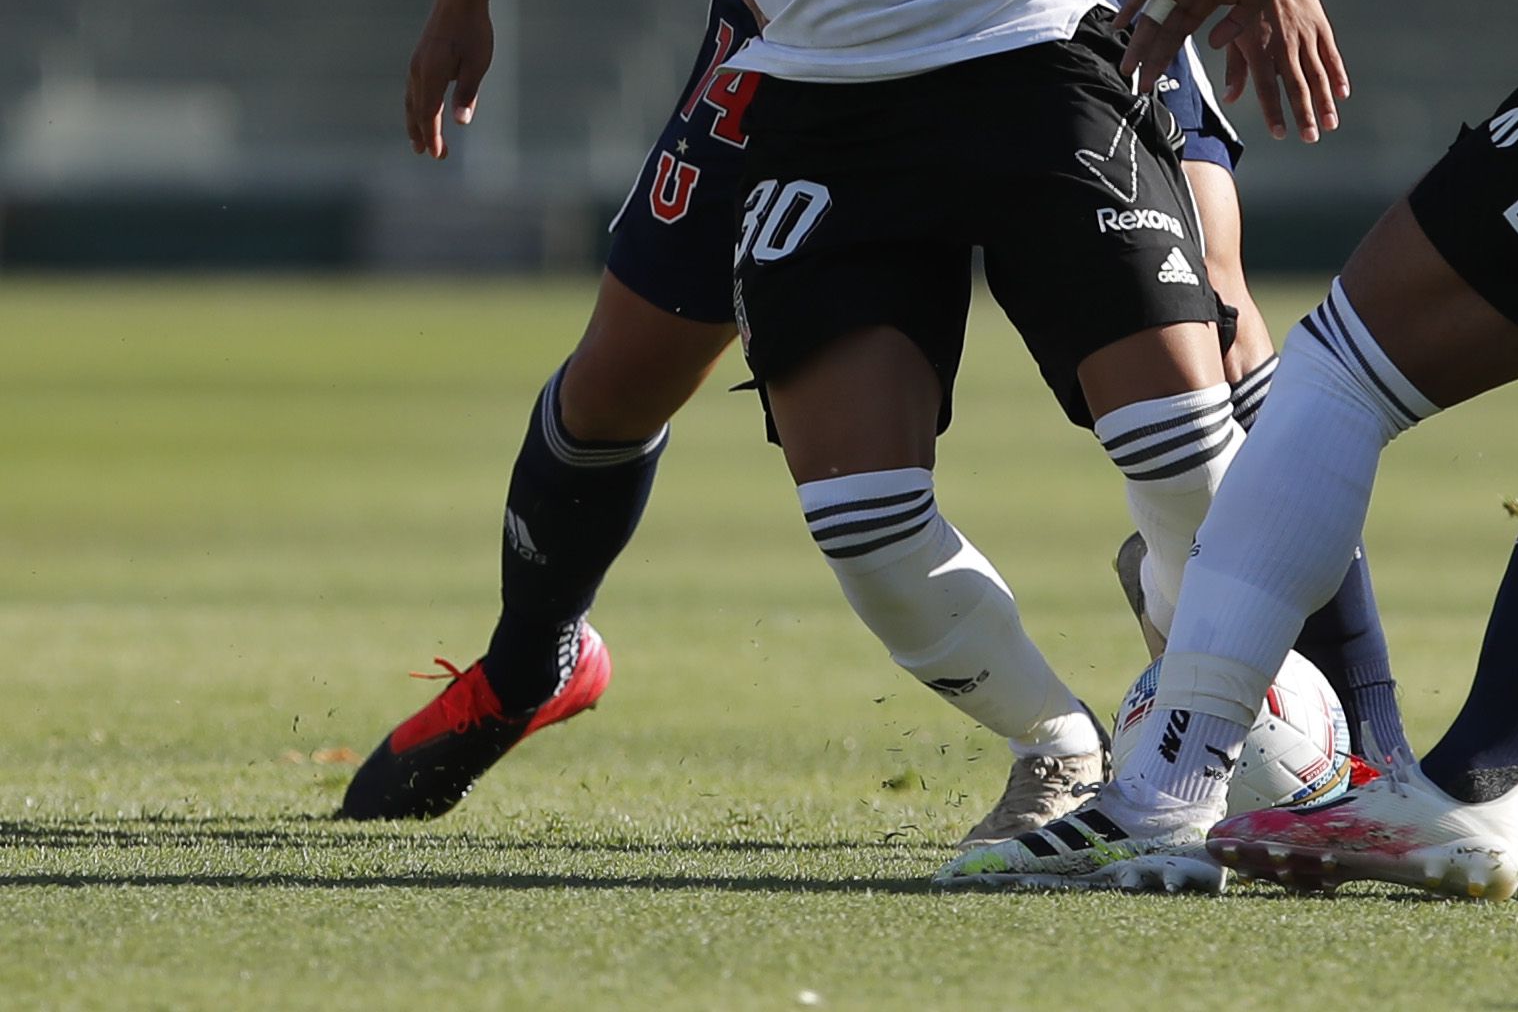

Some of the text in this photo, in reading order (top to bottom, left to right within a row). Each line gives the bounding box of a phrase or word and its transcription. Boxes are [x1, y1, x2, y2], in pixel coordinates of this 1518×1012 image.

[680, 18, 763, 149] 14
[649, 150, 701, 225] U
[734, 179, 832, 268] 30
[1096, 207, 1184, 239] Rexona
